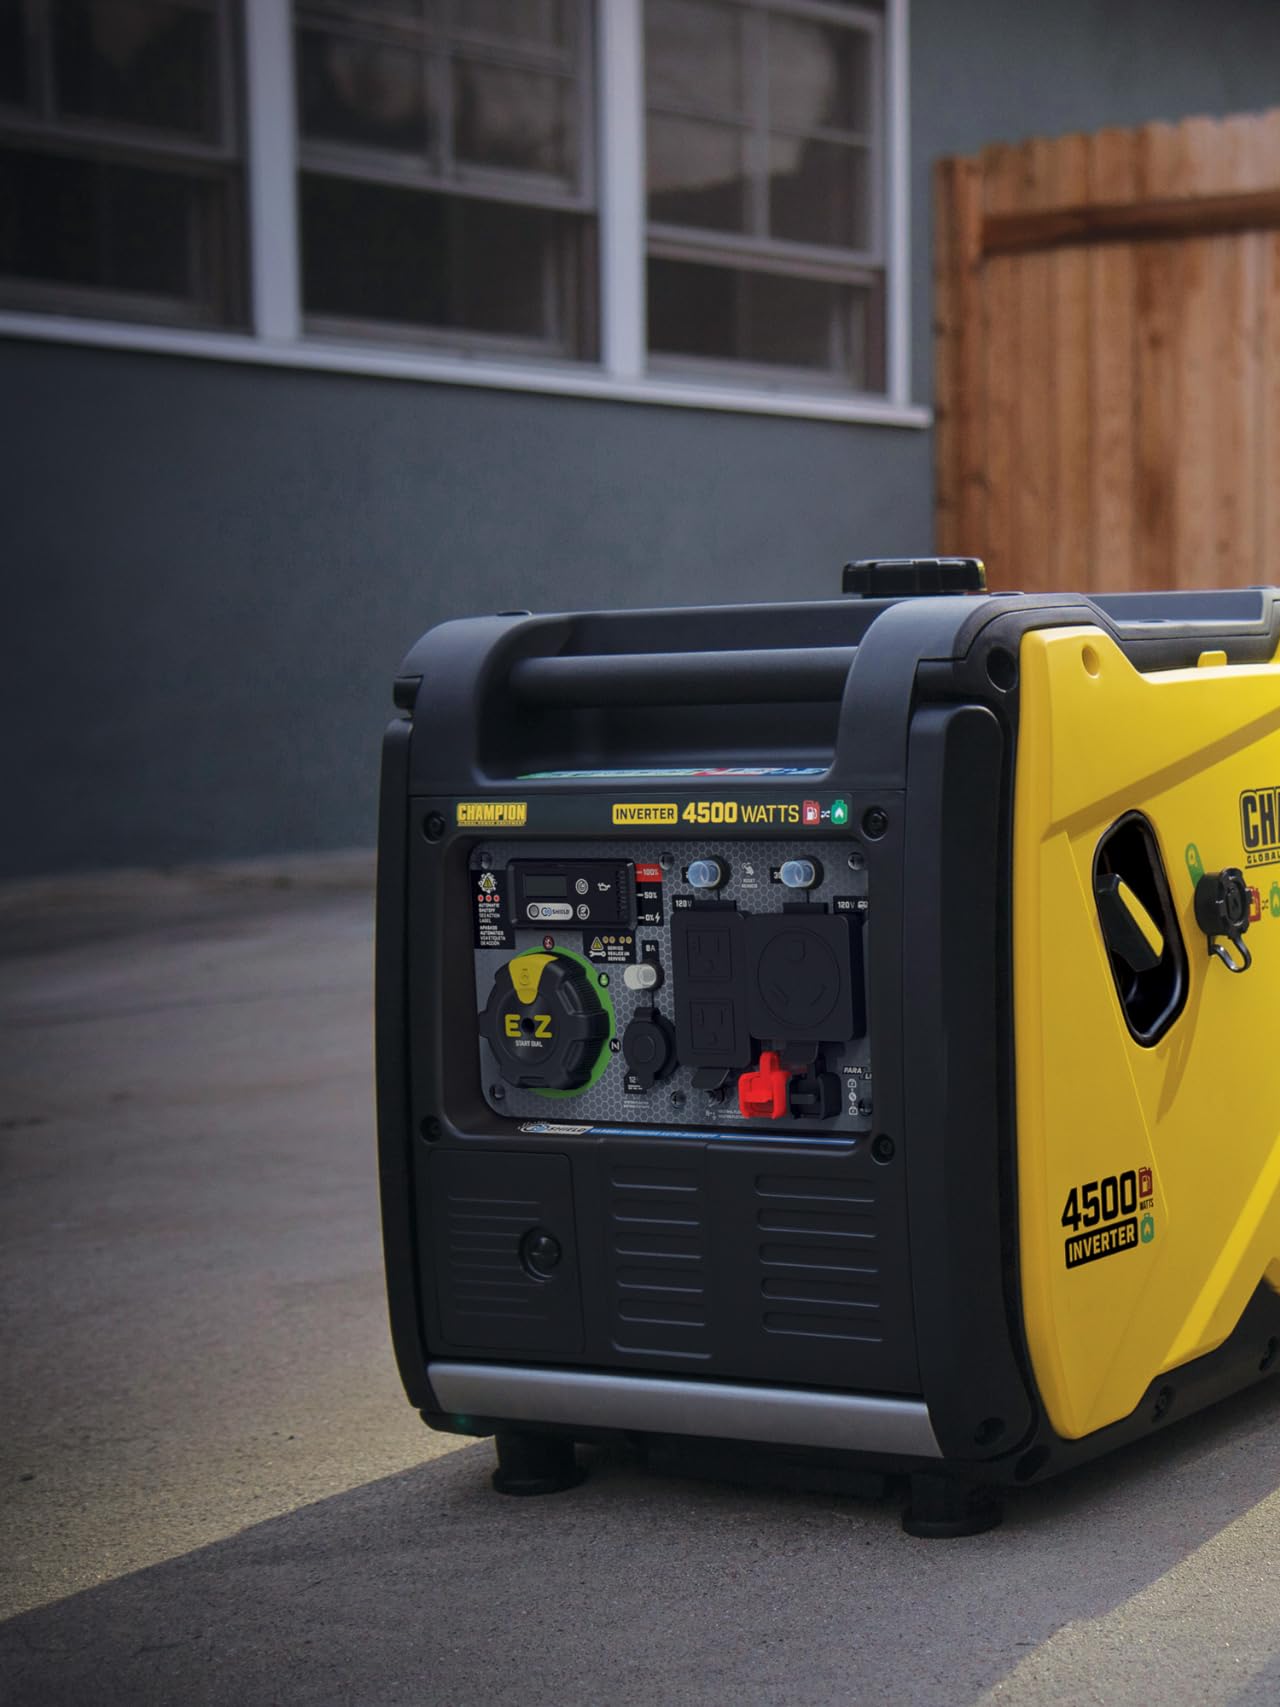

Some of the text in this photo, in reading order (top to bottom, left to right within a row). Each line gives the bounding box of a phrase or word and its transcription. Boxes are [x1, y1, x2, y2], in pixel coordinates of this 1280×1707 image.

[458, 804, 526, 821] CHAMPION
[615, 802, 799, 823] INVERTER 4500 WATTS
[1247, 851, 1280, 864] GLOBAL
[515, 1039, 543, 1048] START DIAL
[610, 1041, 620, 1050] N
[1061, 1169, 1137, 1232] 4500
[1068, 1223, 1135, 1263] INVERTER
